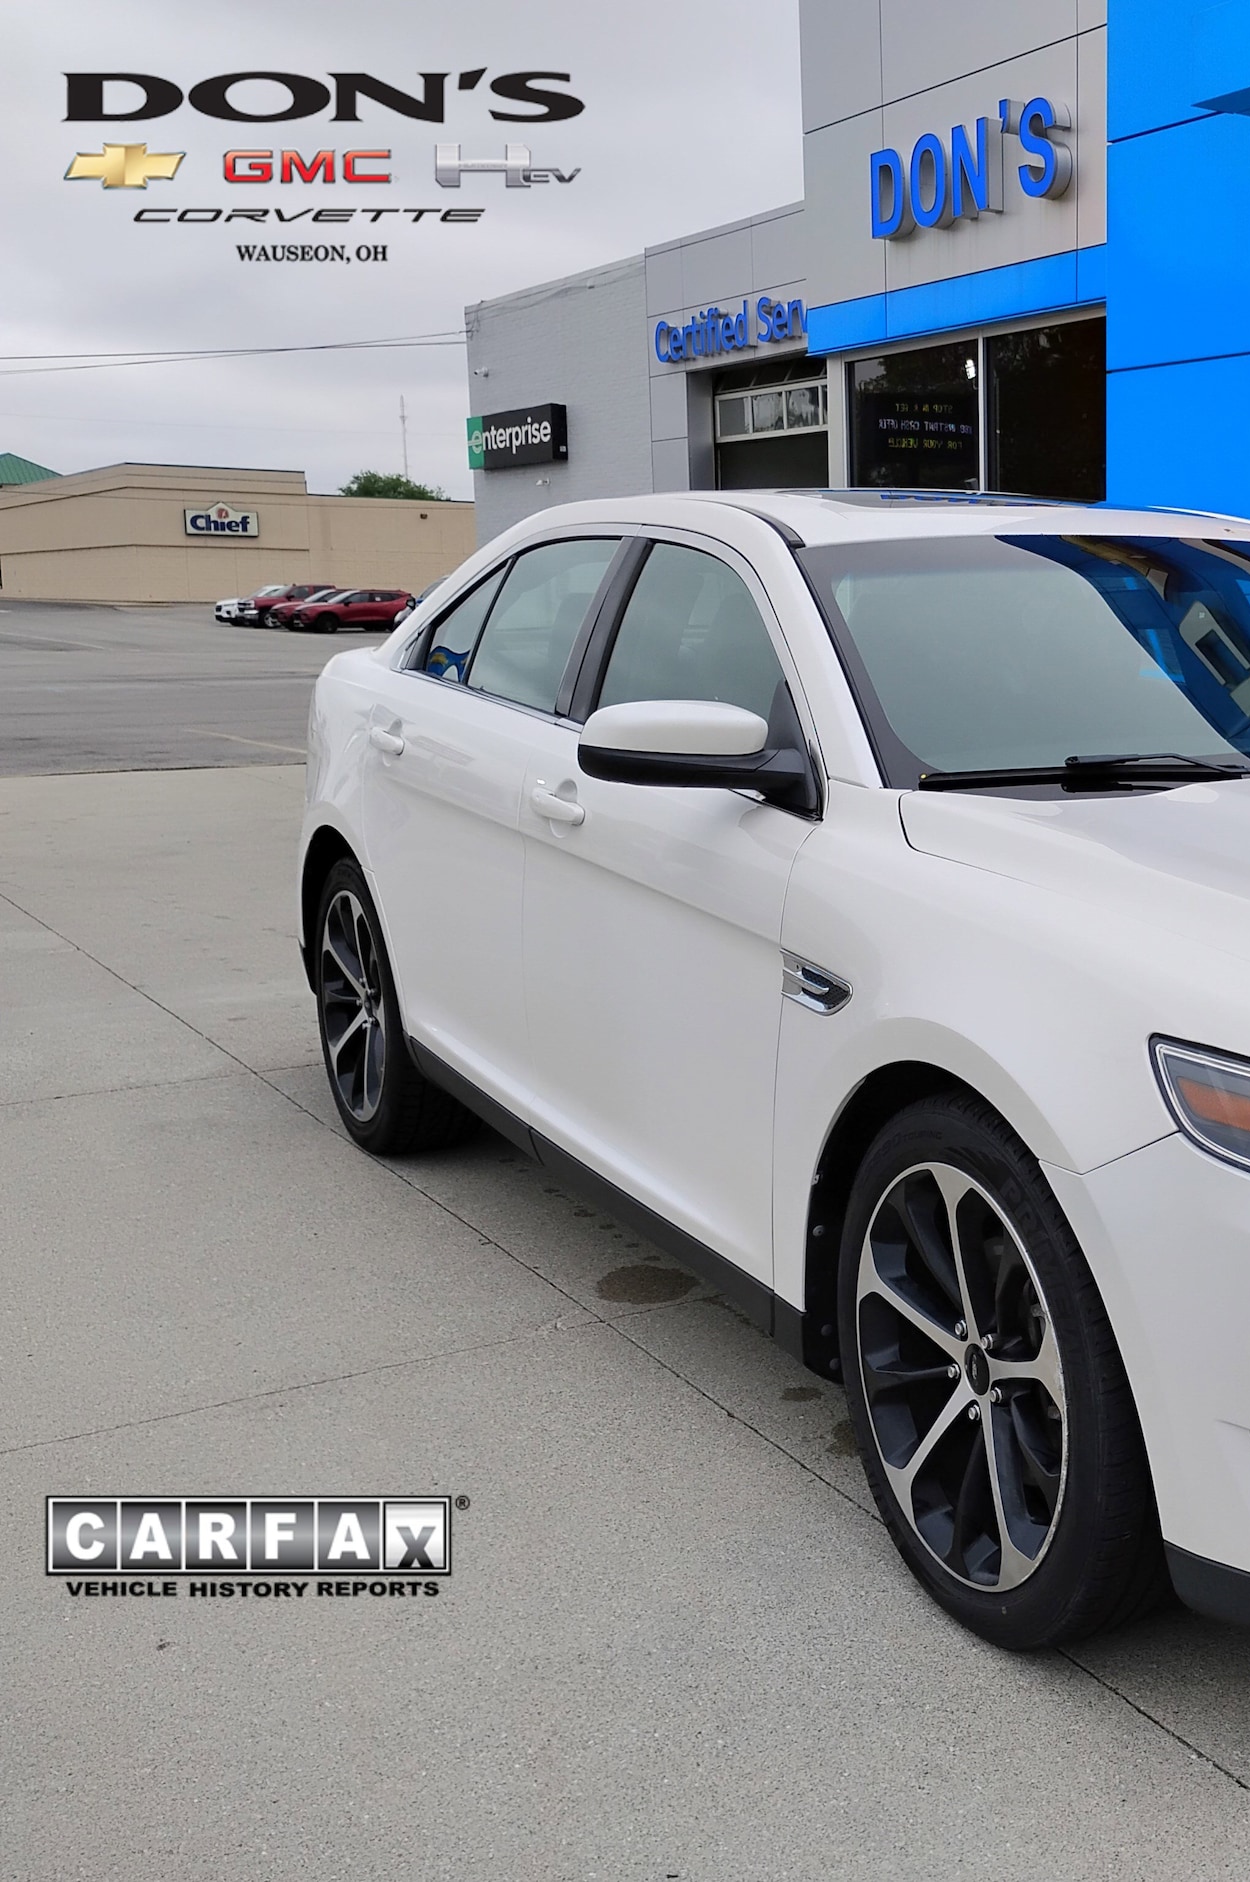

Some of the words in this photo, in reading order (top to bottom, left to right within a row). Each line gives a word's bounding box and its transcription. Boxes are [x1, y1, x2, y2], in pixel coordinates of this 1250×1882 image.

[869, 96, 1060, 240] DON'S
[655, 299, 749, 364] Certified
[469, 416, 552, 455] enterprise
[189, 513, 250, 533] Chief
